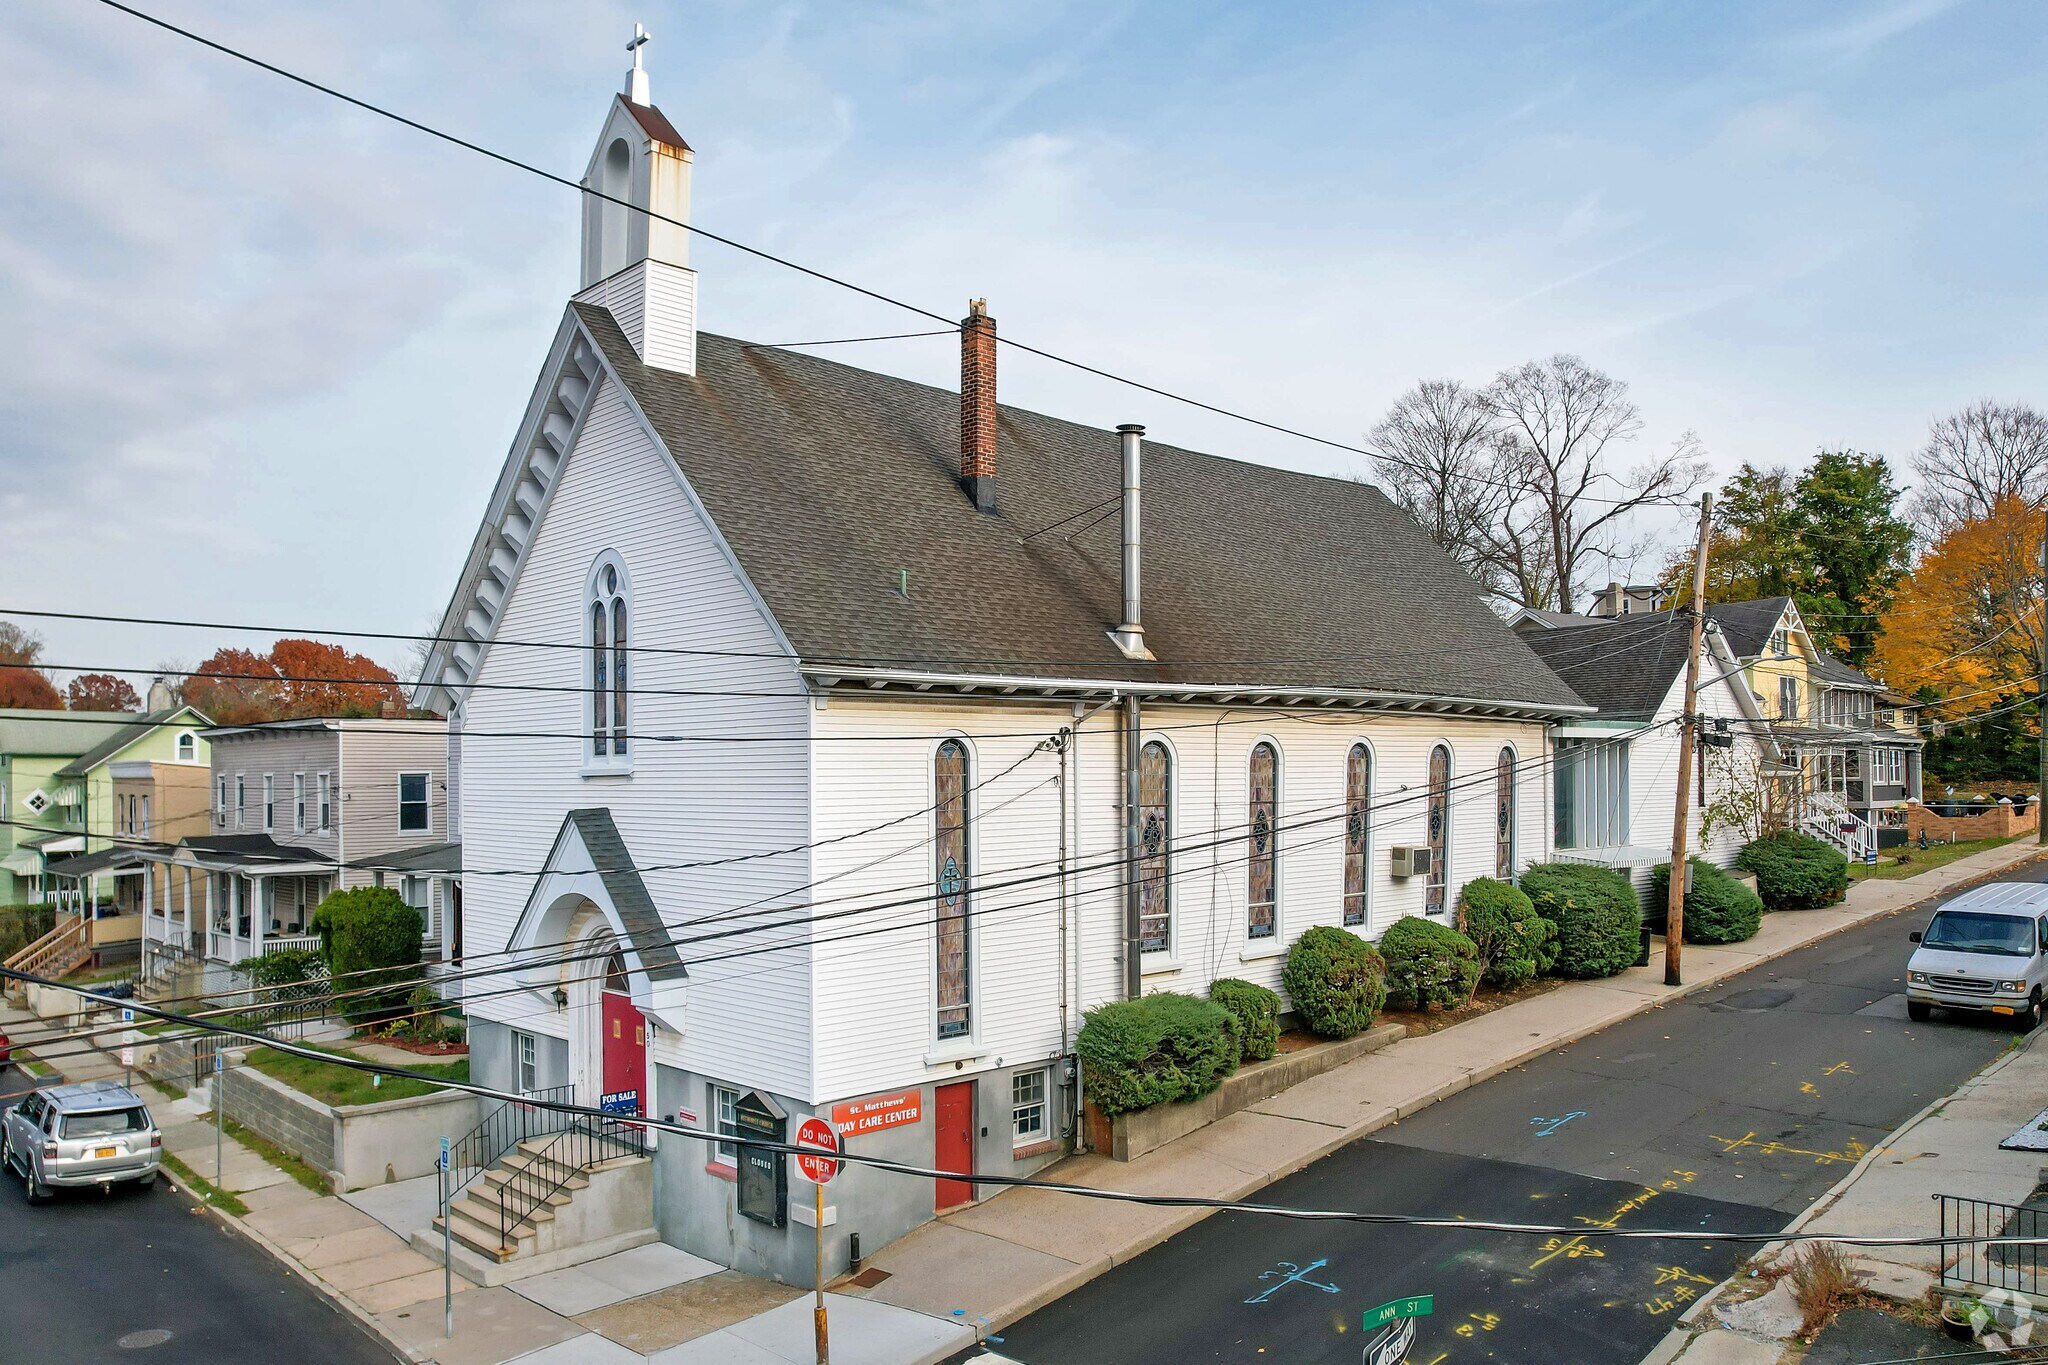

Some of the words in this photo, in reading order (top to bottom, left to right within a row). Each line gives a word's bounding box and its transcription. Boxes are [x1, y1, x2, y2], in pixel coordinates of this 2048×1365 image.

[602, 1095, 617, 1104] FOR
[618, 1090, 637, 1102] SALE
[849, 1106, 861, 1115] St.
[837, 1121, 856, 1134] DAY
[859, 1115, 882, 1129] CARE
[885, 1107, 917, 1124] CENTER
[802, 1128, 814, 1140] DO
[817, 1132, 832, 1146] NOT
[751, 1157, 771, 1170] CLOSED
[804, 1157, 829, 1173] ENTER
[1379, 1306, 1396, 1321] ANN
[1406, 1301, 1419, 1313] ST
[1384, 1340, 1402, 1365] ONE
